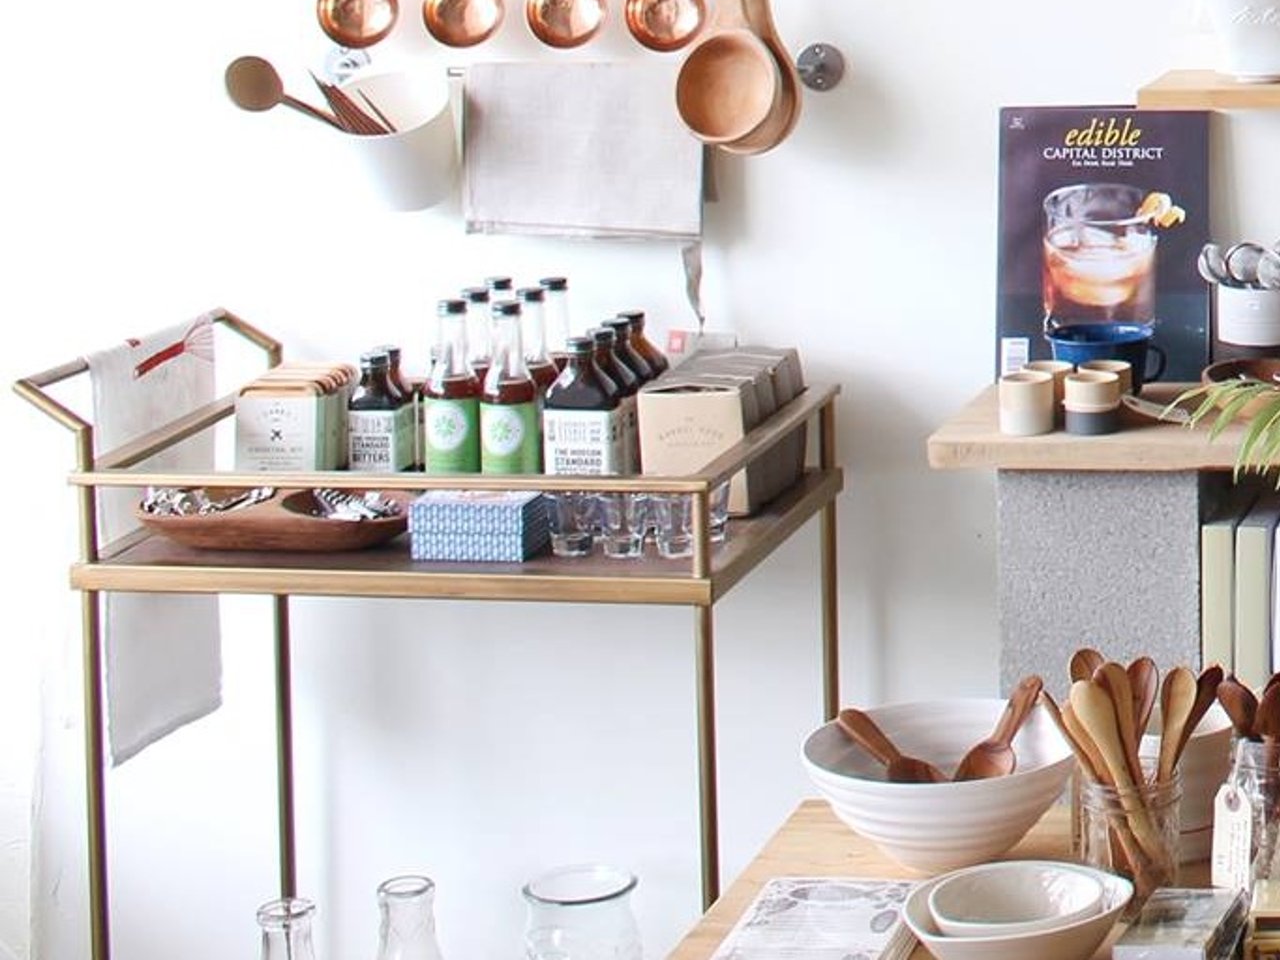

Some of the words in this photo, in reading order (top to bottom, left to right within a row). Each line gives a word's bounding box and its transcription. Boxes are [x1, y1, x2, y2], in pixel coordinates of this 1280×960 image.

[1064, 118, 1142, 147] edible
[1043, 147, 1097, 160] CAPITAL
[1101, 147, 1164, 160] DISTRICT
[352, 453, 390, 463] BITTERS
[555, 457, 603, 467] STANDARD
